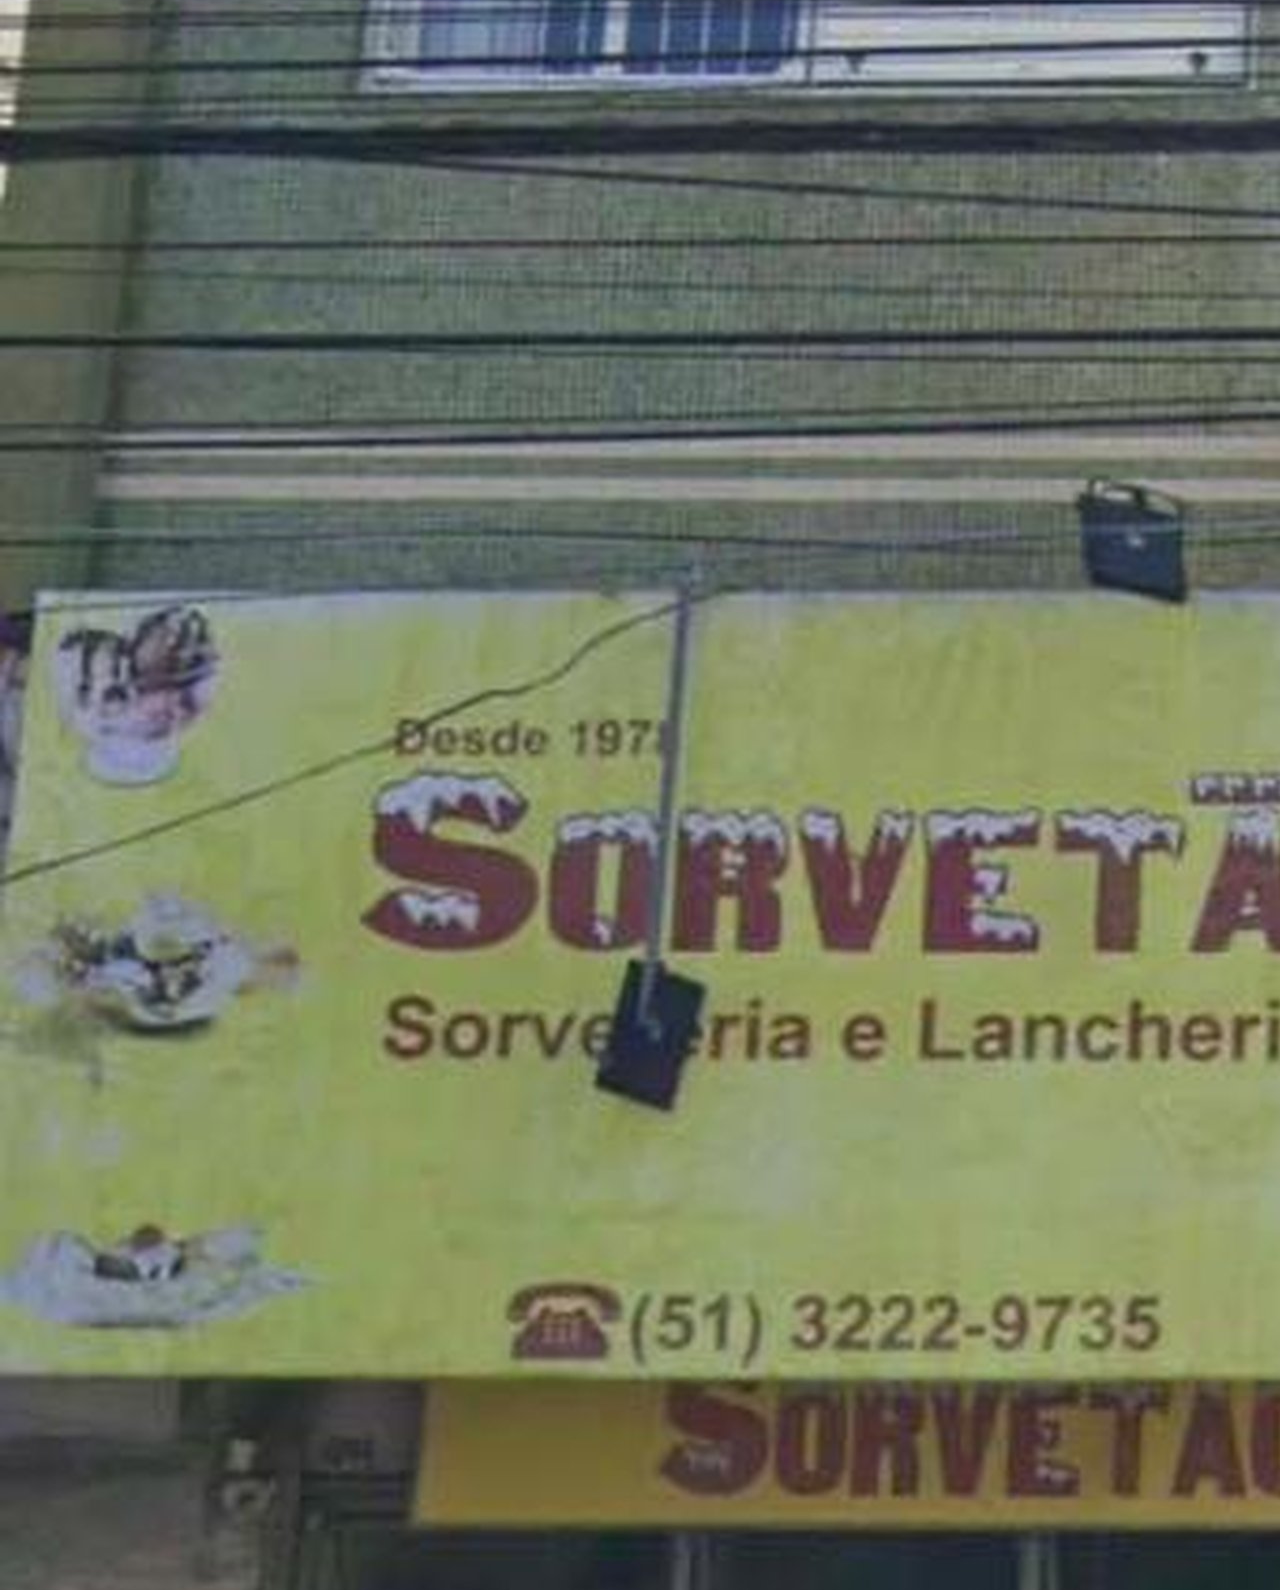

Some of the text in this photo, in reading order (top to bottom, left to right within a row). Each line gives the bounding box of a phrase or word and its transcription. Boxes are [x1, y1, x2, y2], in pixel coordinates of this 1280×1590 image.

[394, 717, 680, 758] Desde 197
[383, 993, 812, 1062] Sorveria
[844, 1008, 884, 1063] e
[630, 1292, 1162, 1369] (51) 3222-9735
